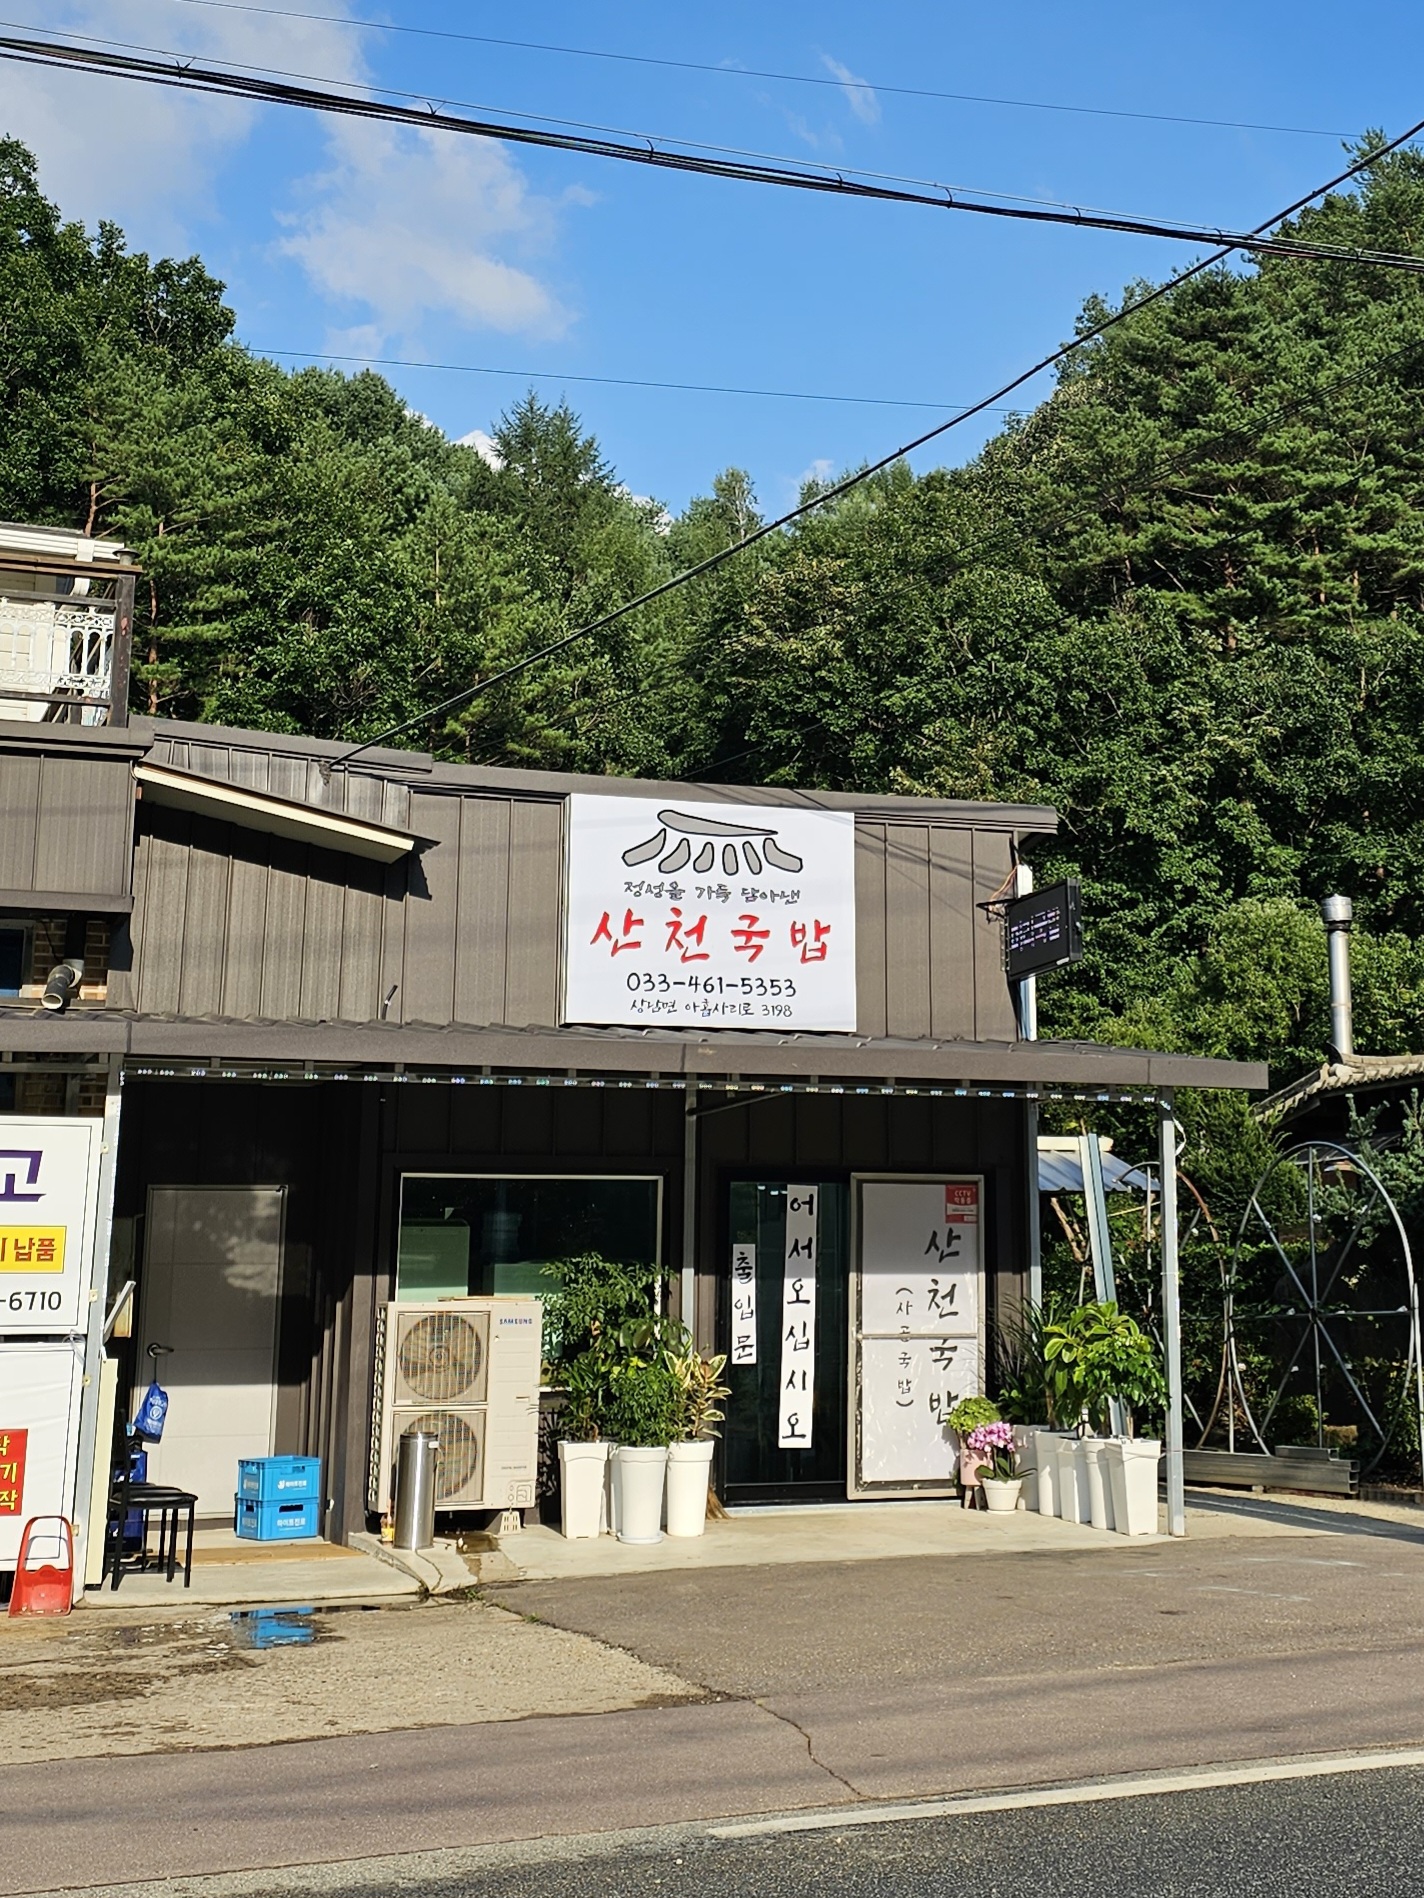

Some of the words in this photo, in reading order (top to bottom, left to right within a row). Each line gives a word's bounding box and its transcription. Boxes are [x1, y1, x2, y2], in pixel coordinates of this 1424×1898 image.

[624, 880, 686, 901] 정성을
[695, 883, 732, 904] 가득
[741, 886, 801, 906] 담아낸
[590, 906, 831, 965] 산천국밥
[626, 972, 797, 998] 033-461-5353
[630, 998, 678, 1014] 상남면
[761, 1004, 793, 1018] 3198
[14, 1237, 57, 1262] 납품
[734, 1251, 755, 1361] 출입문
[782, 1193, 814, 1439] 어서오십시오
